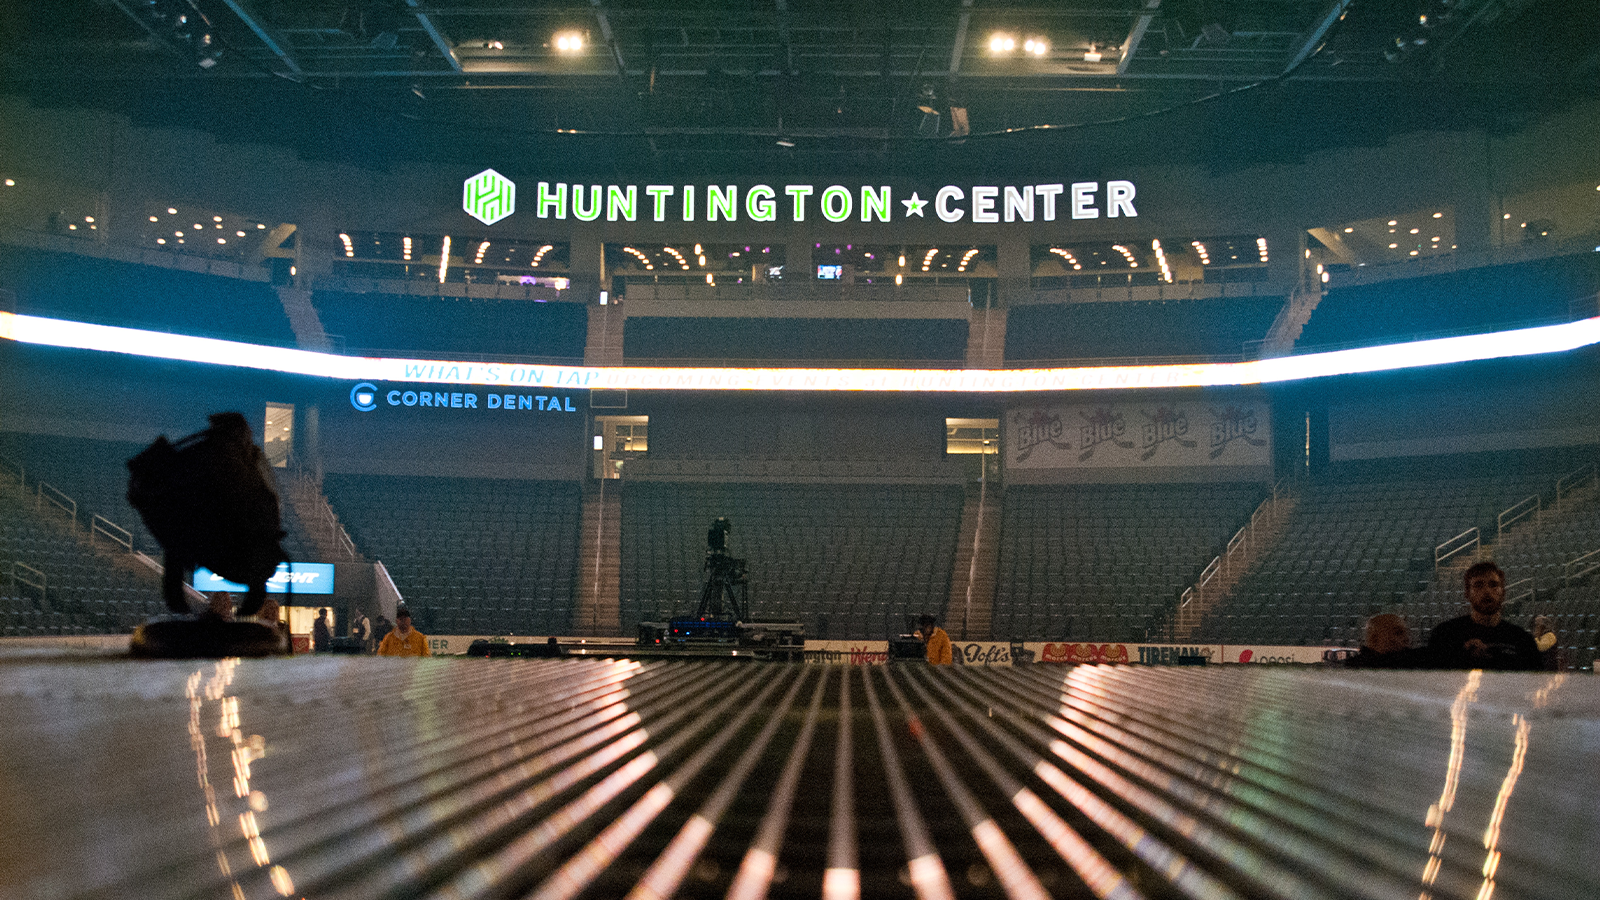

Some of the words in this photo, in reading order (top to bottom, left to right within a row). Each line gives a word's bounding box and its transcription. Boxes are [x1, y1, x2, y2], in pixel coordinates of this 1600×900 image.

[537, 181, 892, 222] HUNTINGTON
[935, 180, 1138, 223] CENTER
[404, 363, 499, 382] WHAT'S
[510, 367, 544, 384] ON
[556, 370, 599, 386] TAP
[606, 373, 741, 387] UPCOMING
[748, 374, 851, 387] EVENTS
[902, 374, 1067, 388] HUNTINGTON
[1080, 371, 1181, 386] CENTER
[387, 390, 478, 409] CORNER
[487, 394, 577, 412] DENTAL
[1018, 417, 1063, 450] Blue
[1079, 417, 1126, 450] Blue
[1142, 416, 1188, 449] Blue
[1210, 417, 1257, 448] Blue
[267, 571, 320, 584] IGHT
